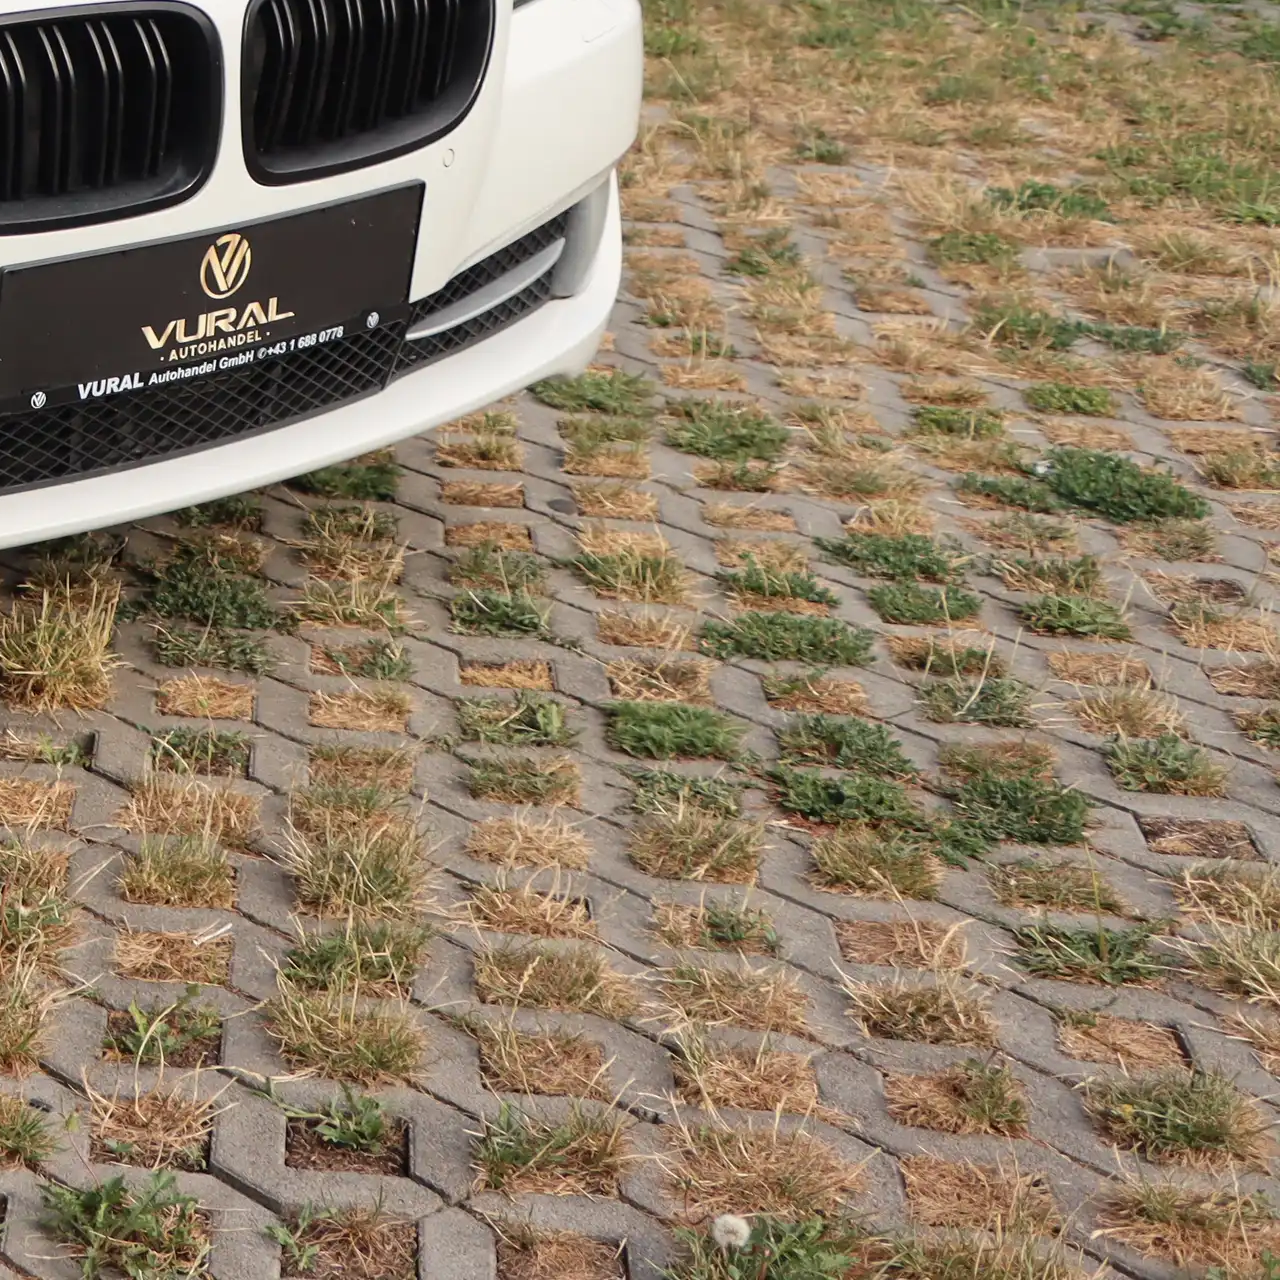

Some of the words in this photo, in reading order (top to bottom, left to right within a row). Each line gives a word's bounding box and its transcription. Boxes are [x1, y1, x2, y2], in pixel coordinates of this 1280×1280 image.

[141, 297, 295, 349] VURAL
[168, 329, 262, 362] AUTOHANDEL
[77, 372, 144, 400] VURAL
[148, 359, 217, 386] Autohandel
[219, 350, 255, 370] GmbH
[289, 339, 296, 352] 1
